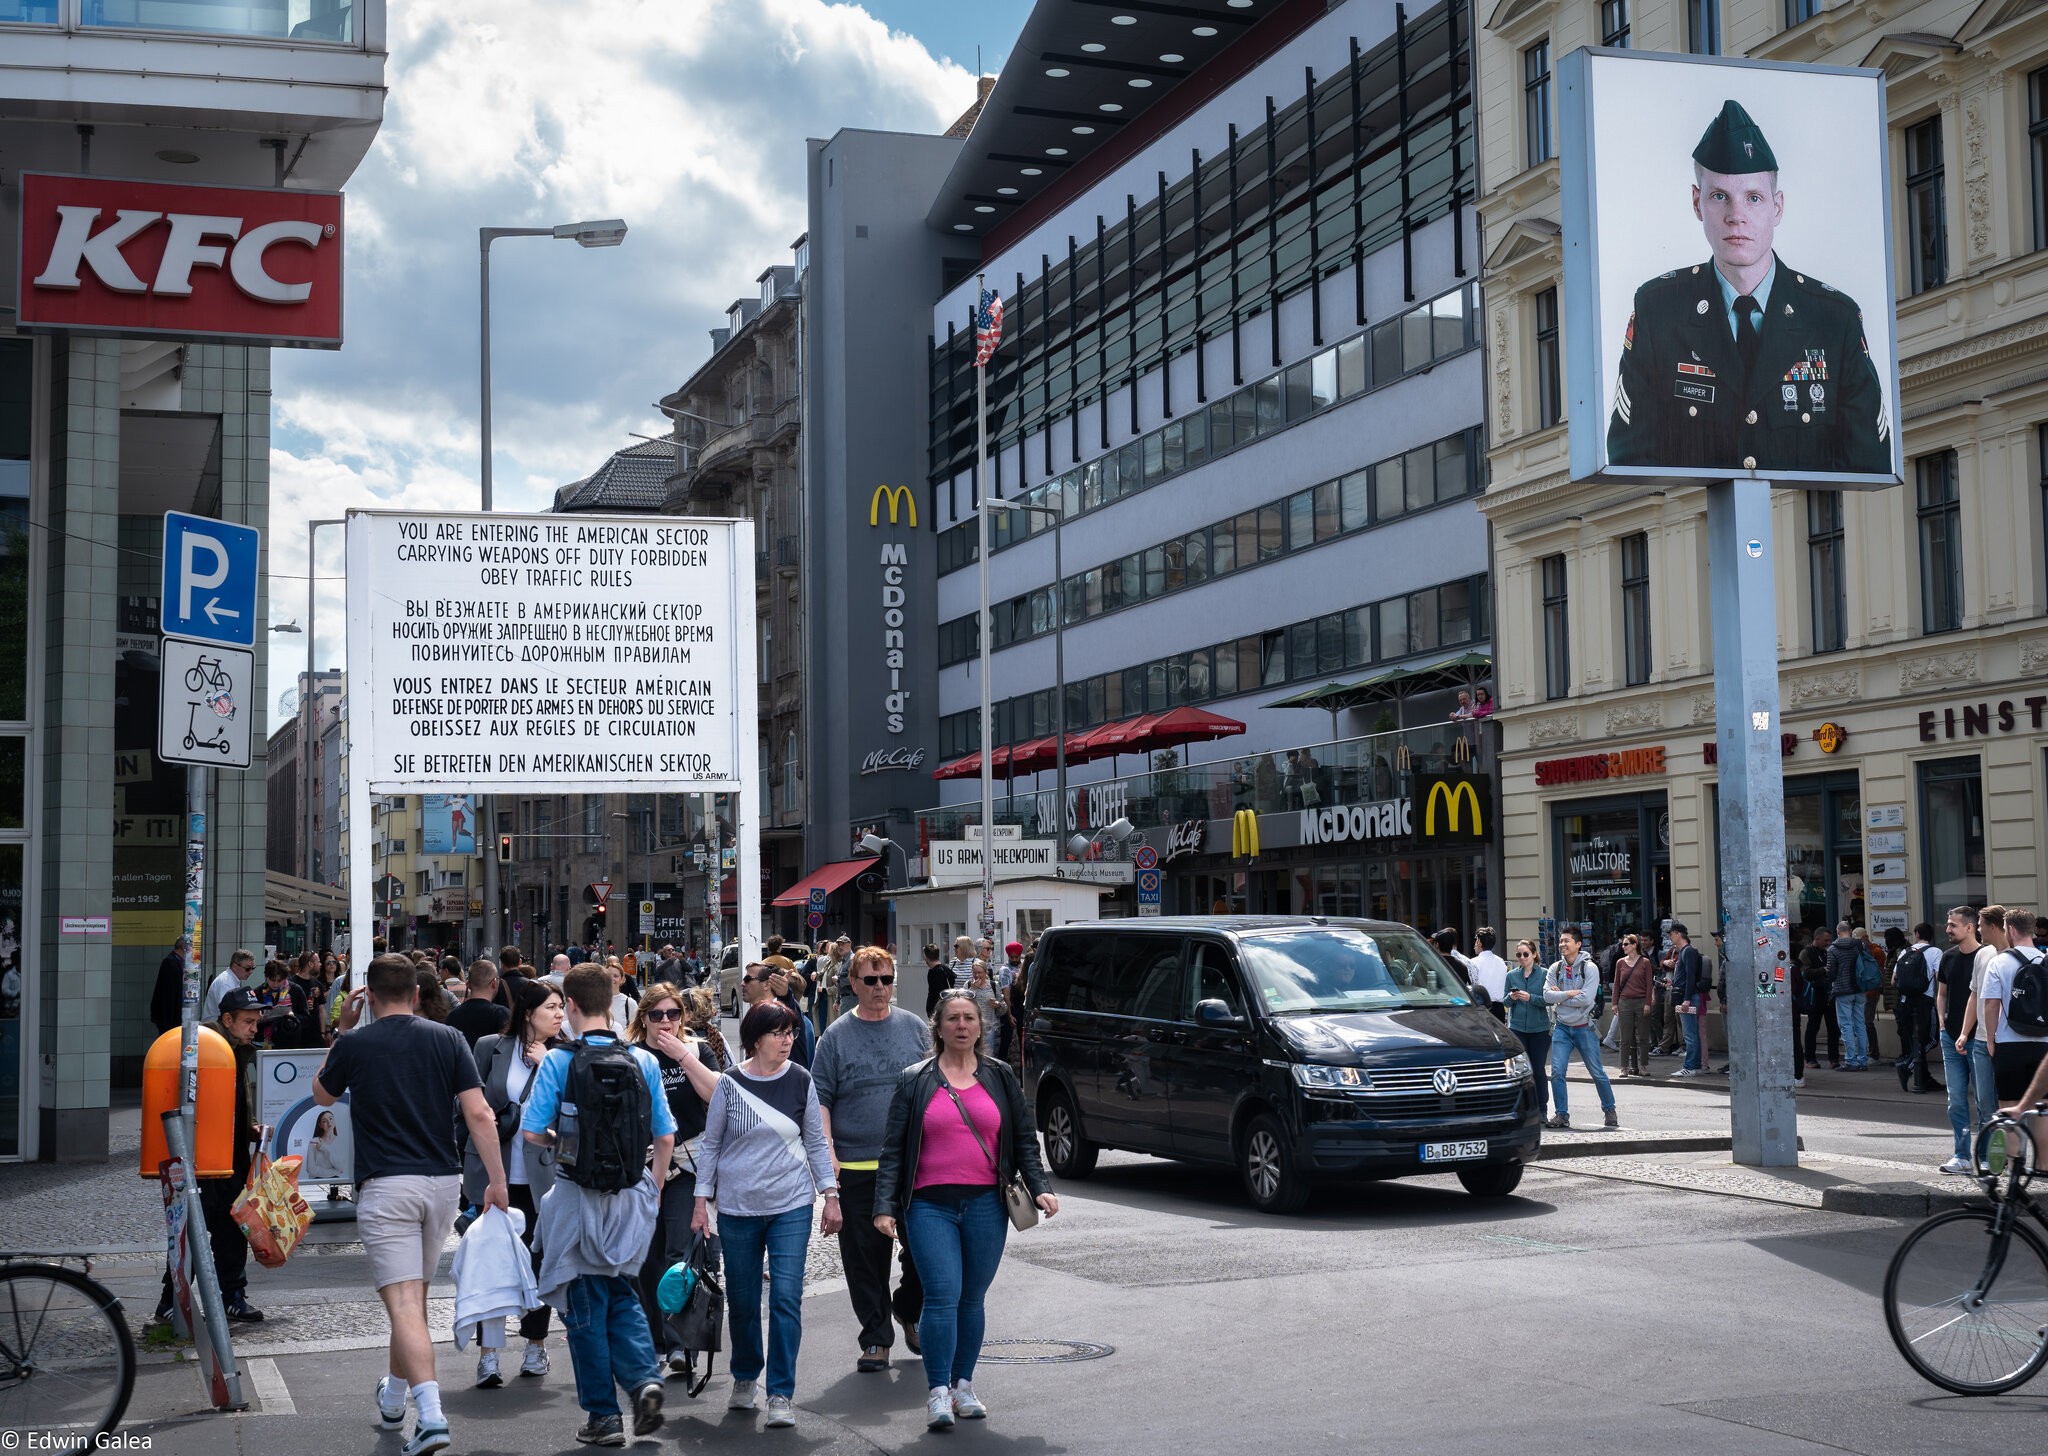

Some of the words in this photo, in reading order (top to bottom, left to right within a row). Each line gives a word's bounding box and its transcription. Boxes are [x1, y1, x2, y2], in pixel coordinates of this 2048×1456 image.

[33, 205, 324, 304] KFC
[1683, 386, 1706, 397] HARPER
[398, 522, 428, 540] YOU
[435, 523, 463, 541] ARE
[472, 523, 539, 543] ENTERING
[545, 525, 569, 543] THE
[577, 526, 648, 545] AMERICAN
[656, 528, 709, 546] SECTOR
[397, 544, 473, 563] CARRYING
[478, 546, 549, 565] WEAPONS
[555, 547, 581, 565] OFF
[589, 548, 624, 566] DUTY
[631, 549, 707, 567] FORBIDDEN
[178, 531, 230, 622] P
[481, 567, 519, 586] OBEY
[526, 568, 582, 587] TRAFFIC
[590, 569, 632, 587] RULES
[406, 599, 429, 619] ВЫ
[518, 602, 526, 619] В
[533, 601, 646, 621] АМЕРИКАНСКИЙ
[653, 603, 702, 621] СЕКТОР
[392, 620, 440, 639] НОСИТЬ
[443, 622, 494, 640] ОРУЖИЕ
[573, 624, 581, 641] В
[586, 624, 670, 642] НЕСЛУЖЕБНОЕ
[675, 625, 713, 643] ВРЕМЯ
[880, 543, 911, 734] McDonald's
[520, 644, 605, 663] ДОРОЖНЫМ
[614, 646, 691, 664] ПРАВИЛАМ
[393, 677, 432, 695] VOUS
[441, 677, 492, 695] ENTREZ
[501, 677, 538, 695] DANS
[546, 678, 558, 694] LE
[566, 677, 627, 696] SECTEUR
[635, 675, 712, 696] AMÉRICAIN
[392, 698, 444, 715] DEFENSE
[447, 698, 462, 715] DE
[464, 698, 508, 715] PORTER
[511, 698, 533, 715] DES
[536, 699, 575, 715] ARMES
[578, 699, 594, 715] EN
[598, 698, 644, 716] DEHORS
[648, 699, 664, 716] DU
[667, 699, 715, 716] SERVICE
[410, 719, 481, 737] OBEISSEZ
[489, 719, 519, 736] AUX
[526, 719, 576, 736] REGLES
[584, 720, 600, 736] DE
[608, 720, 695, 737] CIRCULATION
[1919, 696, 2047, 742] EINST
[393, 754, 415, 774] SIE
[424, 754, 491, 773] BETRETEN
[499, 754, 526, 773] DEN
[532, 753, 653, 773] AMERIKANISCHEN
[660, 753, 711, 772] SEKTOR
[692, 772, 704, 781] US
[705, 772, 729, 781] ARMY
[1037, 789, 1077, 834] SNAS
[1089, 781, 1128, 829] COFFEE
[146, 819, 173, 838] IT!
[957, 849, 984, 865] ARMY
[1570, 852, 1631, 875] WALLSTORE
[121, 873, 143, 882] allen
[144, 873, 172, 884] Tagen
[1068, 868, 1098, 877] Jüdsches
[1099, 868, 1125, 877] Museum
[112, 895, 135, 904] since
[137, 895, 160, 904] 1962
[1140, 893, 1159, 901] TAXI
[656, 917, 686, 927] FFIC
[1426, 1145, 1435, 1158] B
[1442, 1144, 1457, 1157] BB
[1458, 1142, 1487, 1156] 7532
